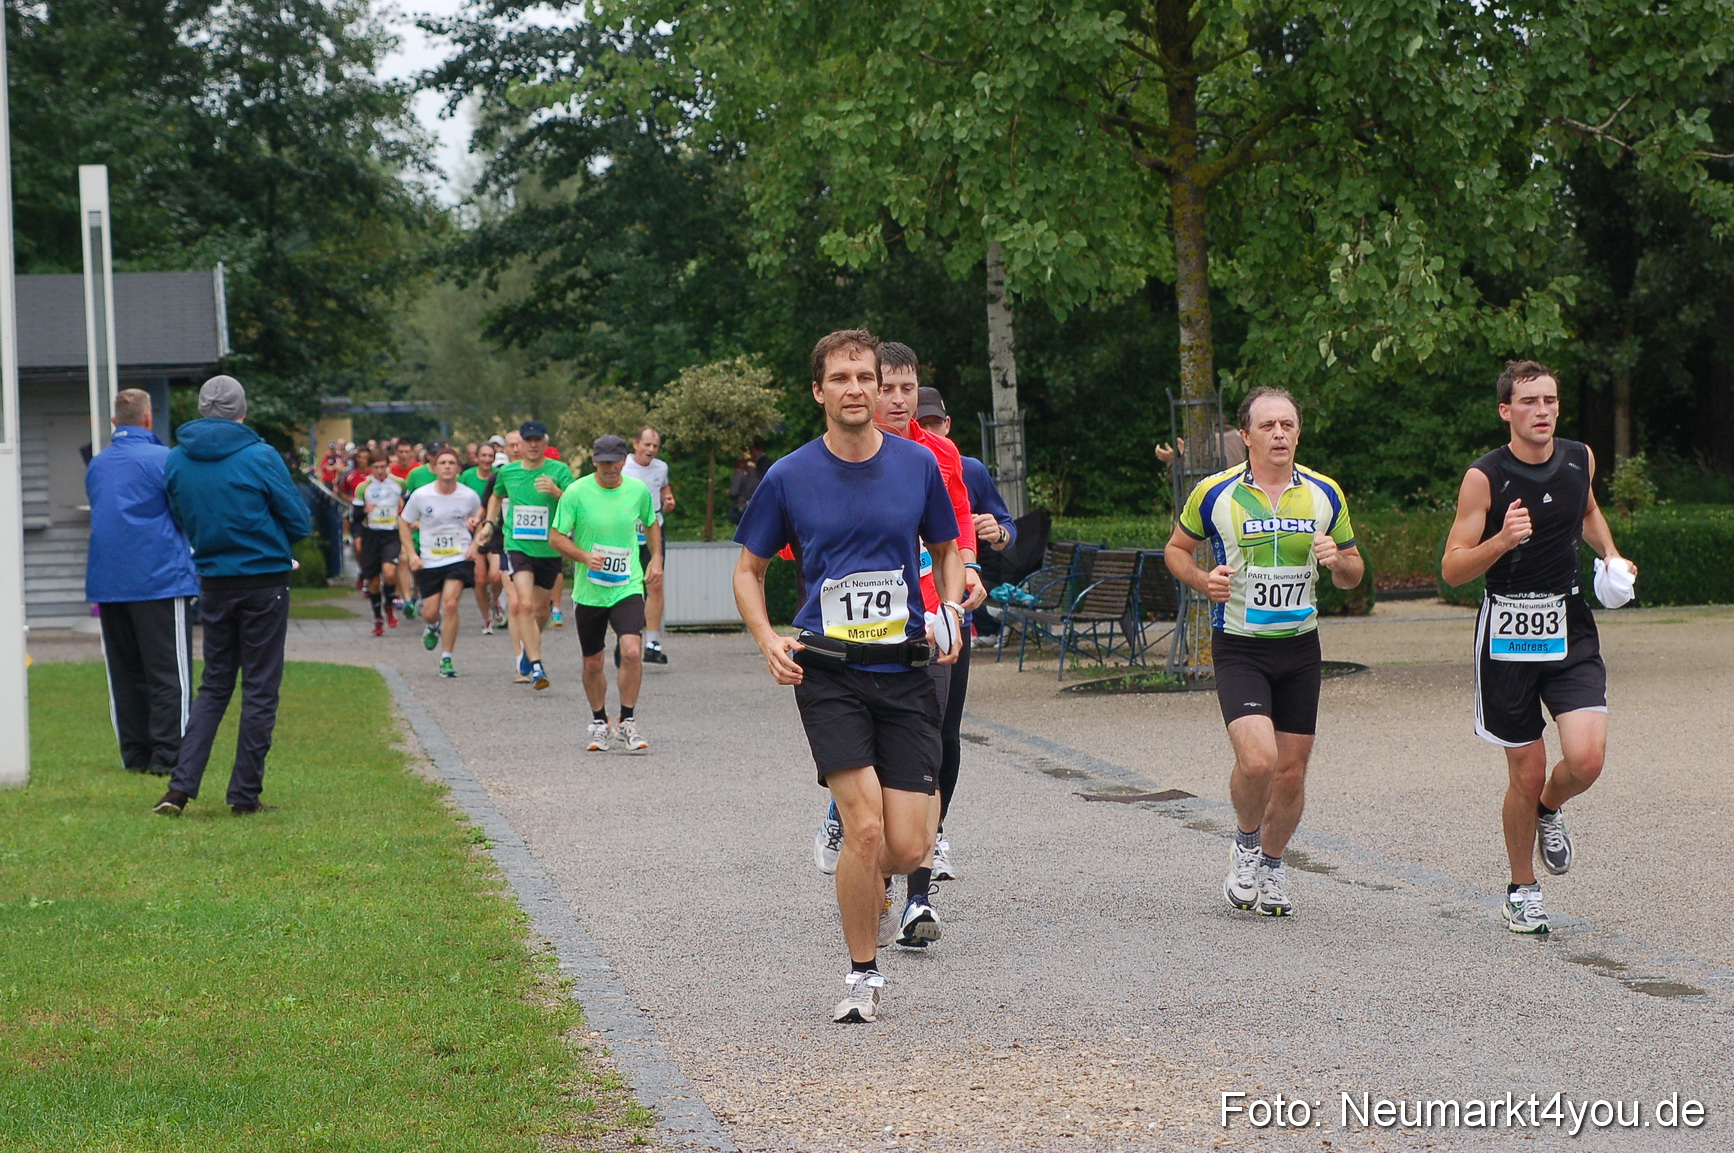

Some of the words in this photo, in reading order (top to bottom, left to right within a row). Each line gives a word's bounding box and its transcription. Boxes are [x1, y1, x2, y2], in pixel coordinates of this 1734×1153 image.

[516, 513, 543, 526] 2821
[1243, 516, 1316, 534] BOCK
[434, 536, 453, 548] 491
[602, 556, 626, 573] 905
[1247, 572, 1272, 581] PARTL
[852, 578, 894, 588] Neumarkt
[1253, 582, 1306, 608] 3077
[840, 590, 892, 621] 179
[1519, 602, 1554, 610] Neumarkt
[1499, 611, 1559, 635] 2893
[848, 627, 888, 639] Marcus
[1508, 641, 1549, 652] Andreas
